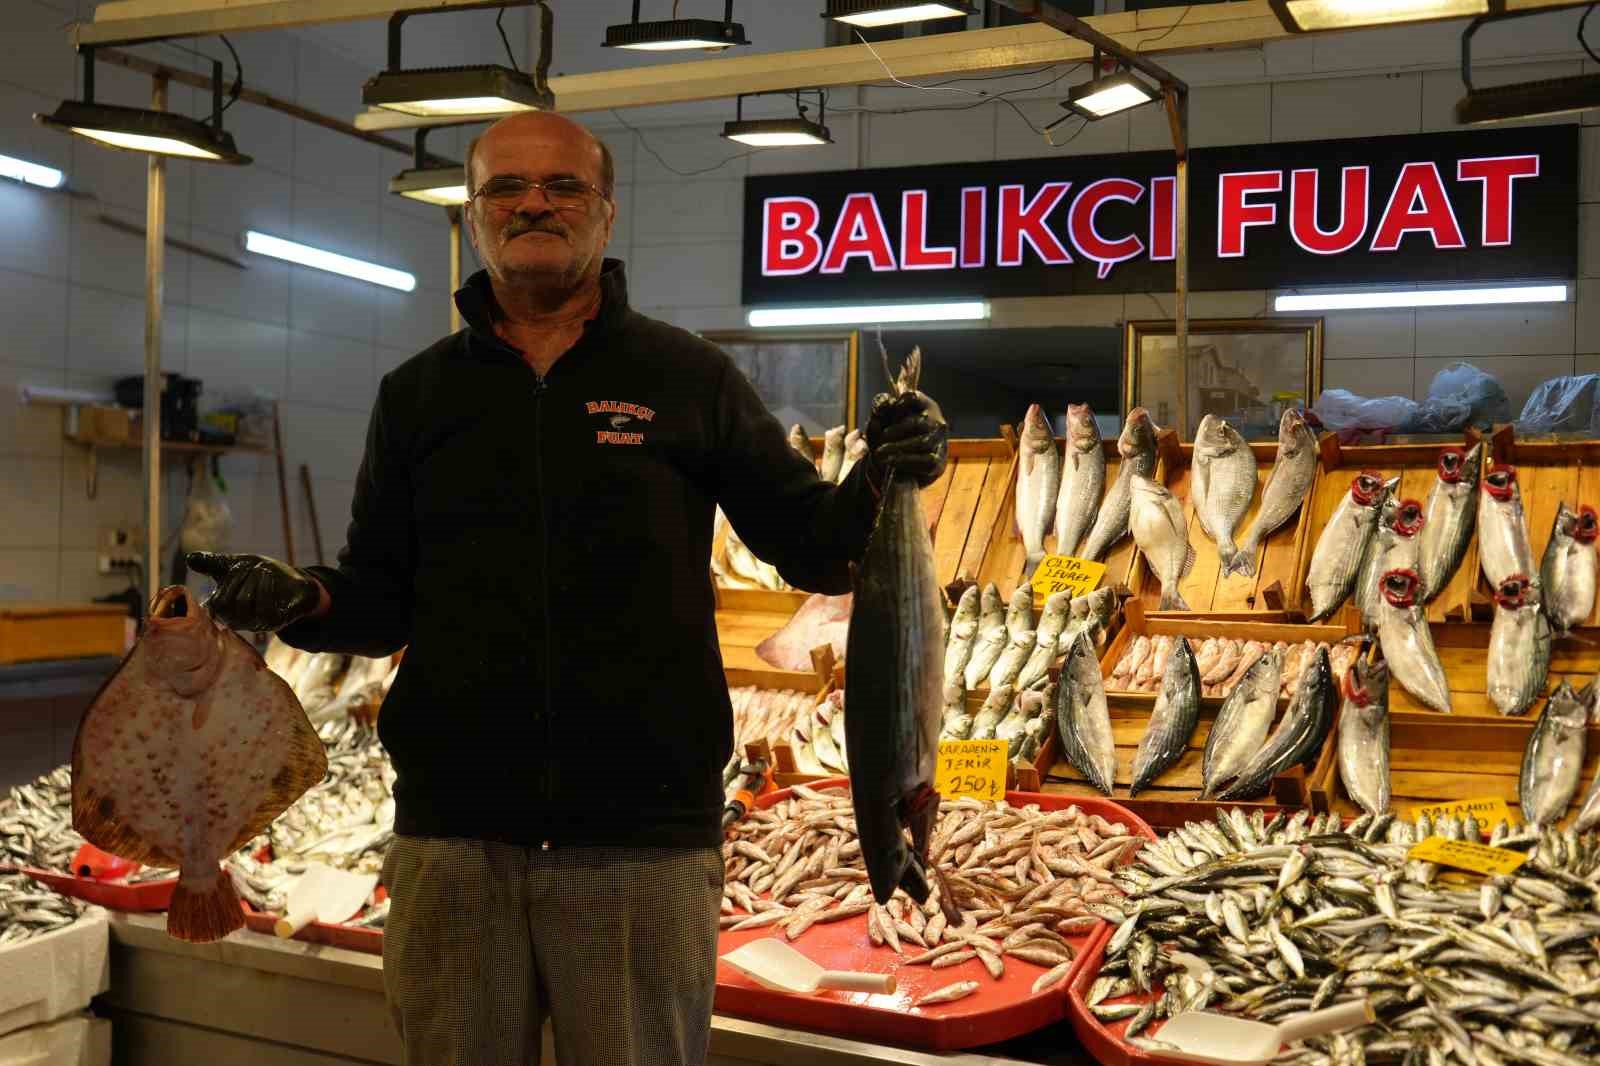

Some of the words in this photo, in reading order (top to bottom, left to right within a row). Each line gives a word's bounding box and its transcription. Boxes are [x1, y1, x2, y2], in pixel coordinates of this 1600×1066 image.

[761, 175, 1177, 281] BALIKÇI
[1217, 153, 1541, 259] FUAT
[596, 430, 644, 445] FUAT
[950, 775, 986, 794] 250
